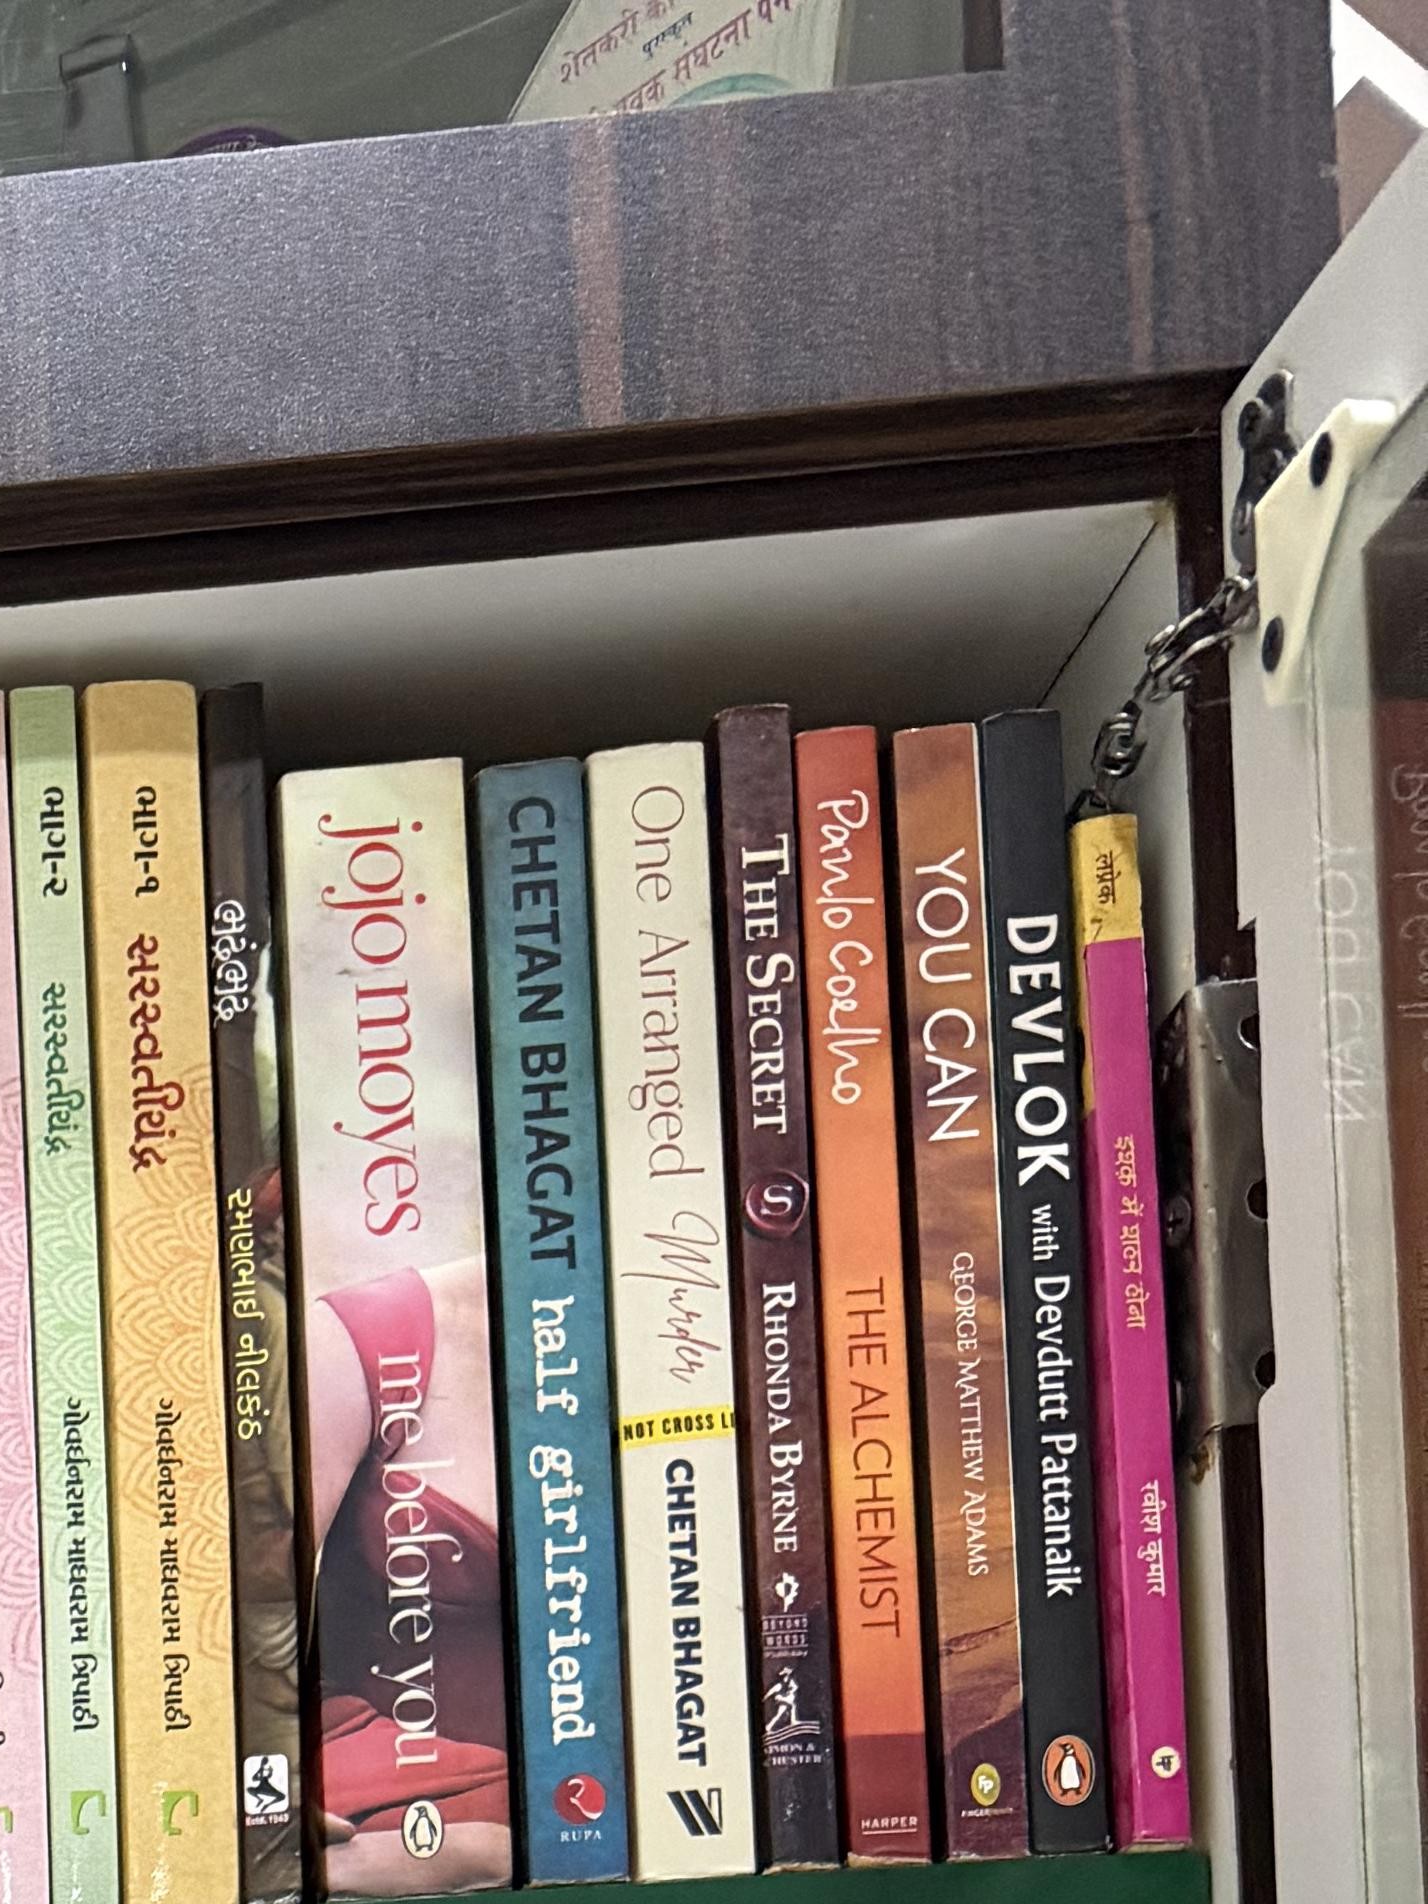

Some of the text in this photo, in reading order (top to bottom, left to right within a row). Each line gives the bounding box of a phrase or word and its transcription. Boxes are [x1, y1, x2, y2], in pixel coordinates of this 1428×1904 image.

[318, 814, 424, 1236] jojo moyes
[509, 797, 575, 1269] CHETAN BHAGAT
[740, 833, 791, 1135] THE SECRET
[1006, 913, 1081, 1600] DEVLOK with Devdutt Pattanaik
[369, 1352, 469, 1769] me before you
[529, 1296, 593, 1747] half girlfriend
[560, 1829, 604, 1842] RUPA
